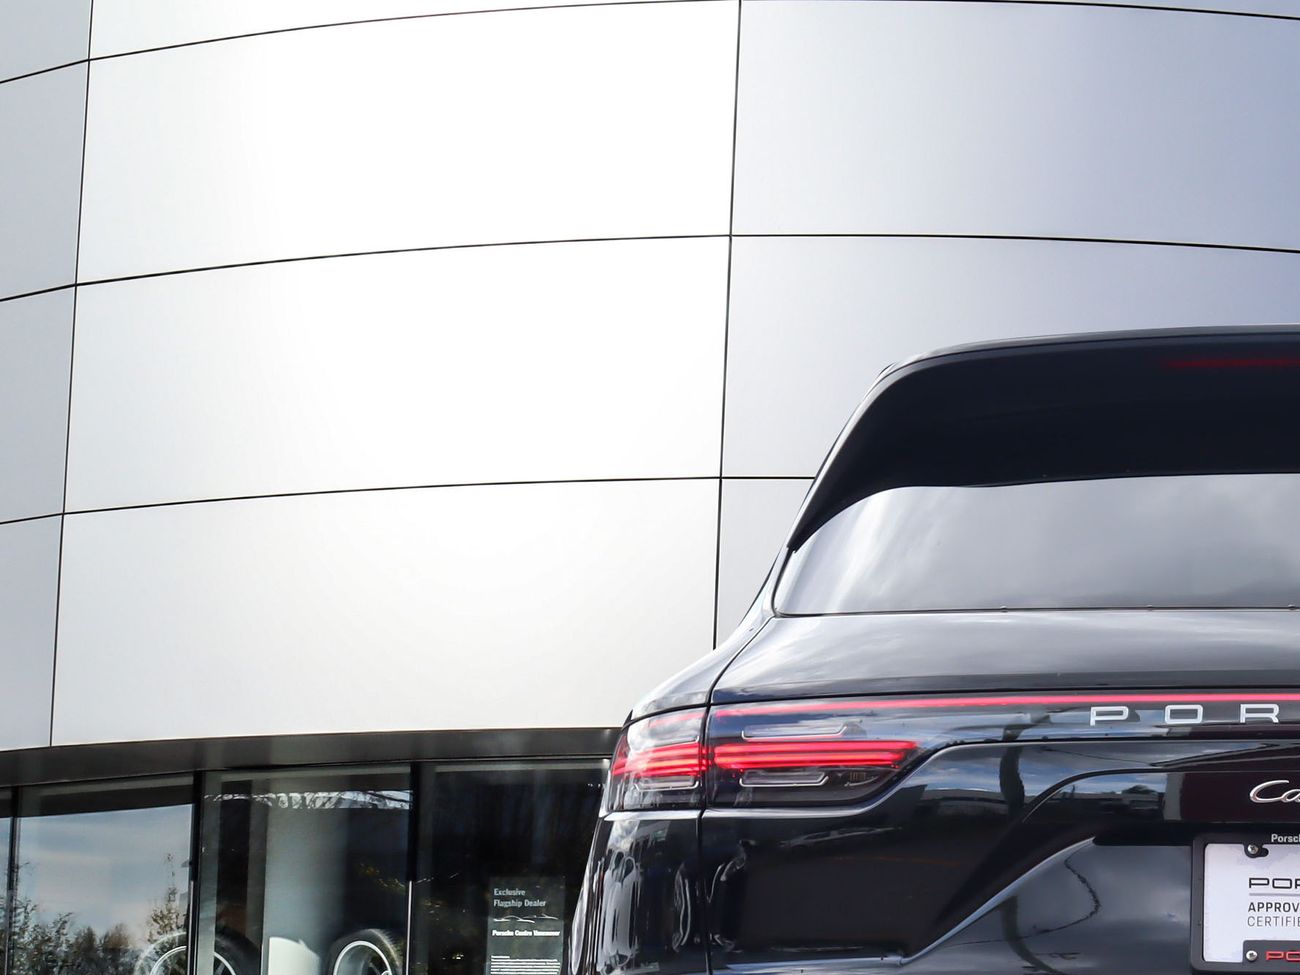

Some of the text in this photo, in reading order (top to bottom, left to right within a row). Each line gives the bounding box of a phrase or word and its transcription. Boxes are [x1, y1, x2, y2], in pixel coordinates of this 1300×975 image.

[494, 888, 525, 896] Exclusive
[494, 899, 546, 908] Flagship Dealer
